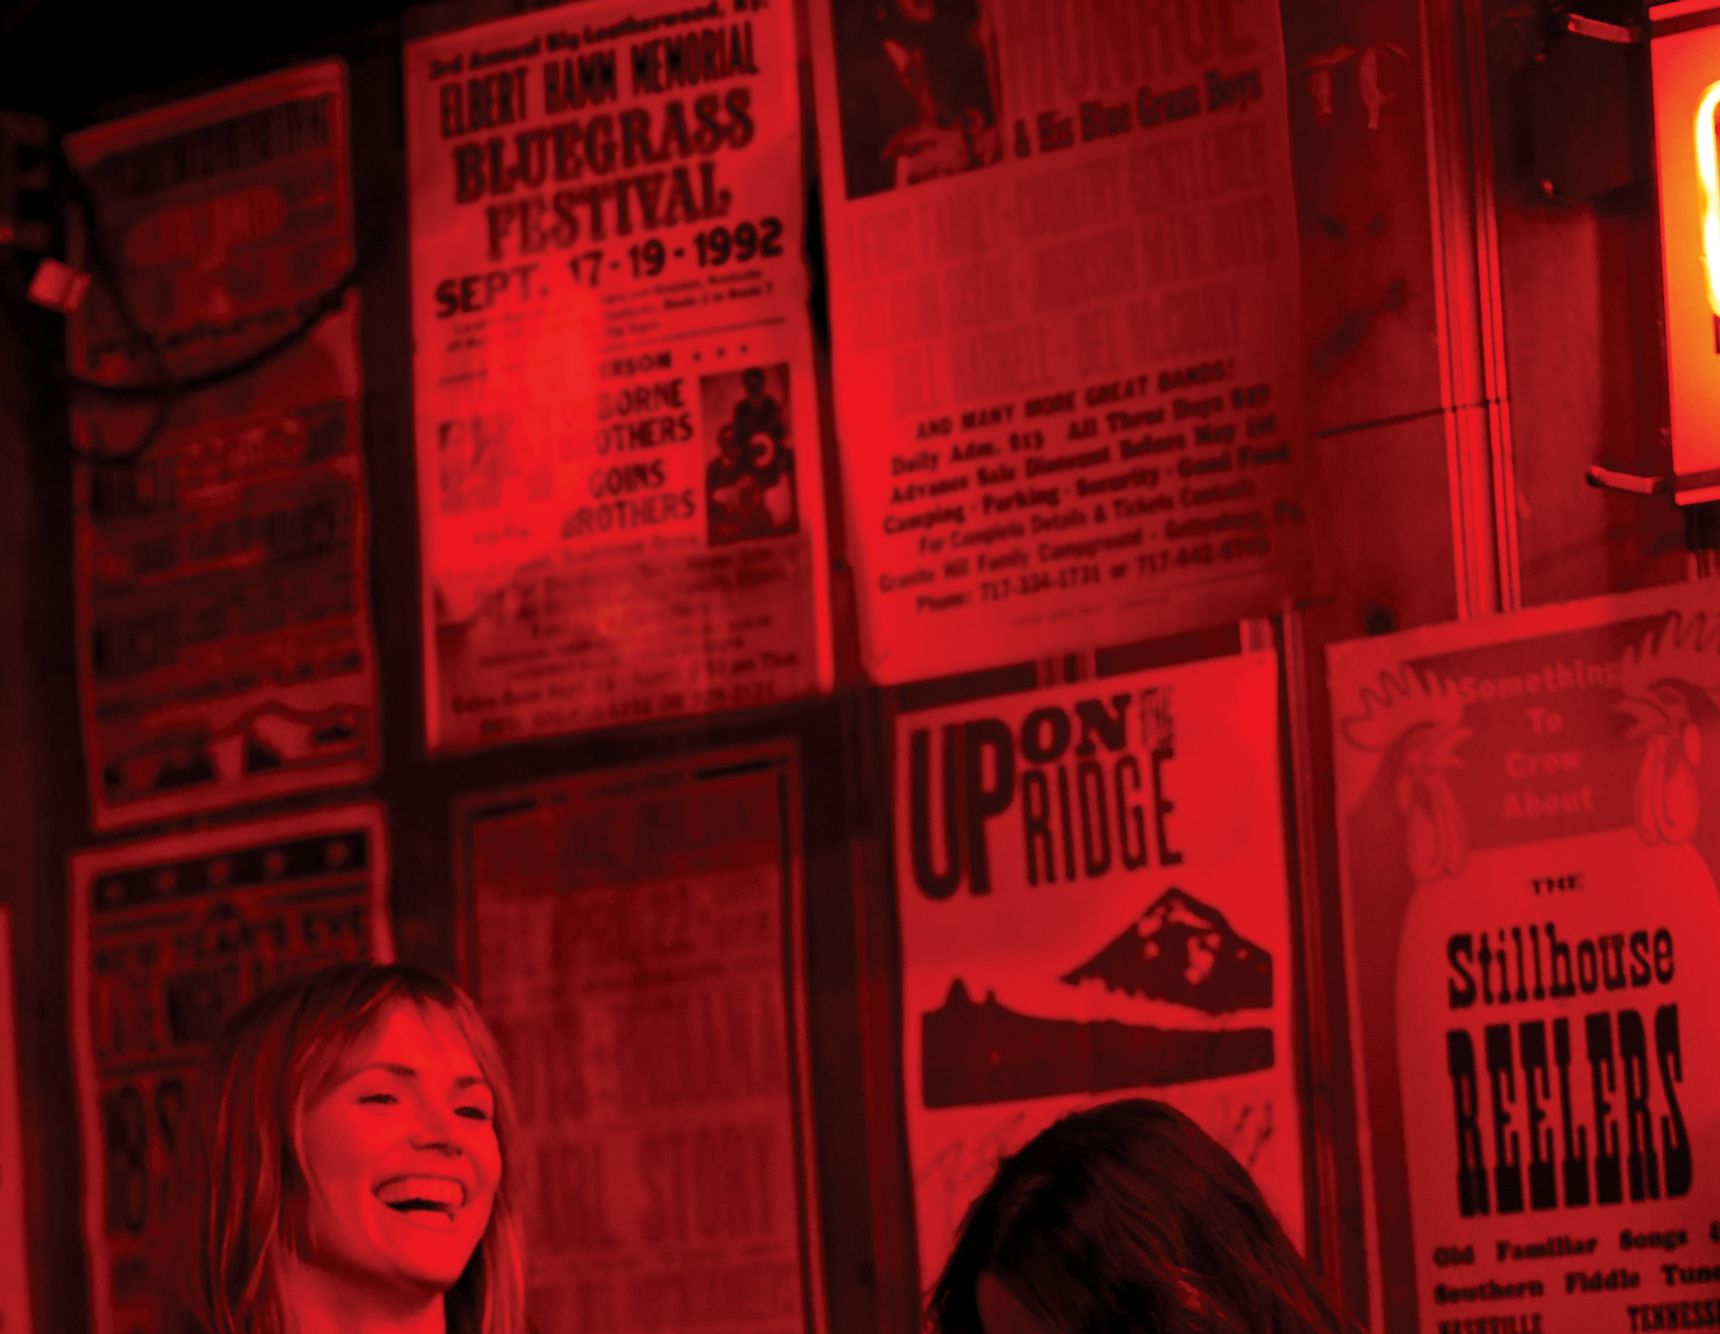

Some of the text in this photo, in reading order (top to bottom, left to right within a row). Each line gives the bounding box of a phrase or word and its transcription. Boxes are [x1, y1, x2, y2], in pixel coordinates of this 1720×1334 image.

[438, 66, 529, 139] ELBERT
[629, 20, 761, 97] MEMORIAL
[1036, 108, 1076, 154] His
[1077, 97, 1134, 144] Blue
[1134, 83, 1202, 130] Grass
[1202, 66, 1264, 114] Boys
[453, 86, 756, 205] BLUEGRASS
[486, 161, 732, 263] FESTIVAL
[434, 263, 549, 320] SEPT.
[890, 449, 940, 477] Daily
[1066, 414, 1099, 442] All
[1105, 408, 1165, 434] Three
[1172, 395, 1225, 421] Days
[915, 415, 954, 442] AND
[959, 403, 1016, 433] MANY
[1023, 390, 1077, 420] MORE
[1083, 375, 1149, 409] GREAT
[882, 504, 968, 536] Camping
[980, 485, 1062, 515] Parking
[1074, 467, 1159, 498] Security
[1177, 450, 1233, 479] Good
[889, 475, 970, 506] Advance
[975, 462, 1018, 488] Sale
[1023, 446, 1113, 479] Discount
[1119, 433, 1187, 460] Before
[949, 521, 1027, 550] Complete
[1526, 706, 1565, 736] To
[911, 718, 1014, 898] UP
[1020, 692, 1133, 764] ON
[1502, 784, 1595, 819] About
[1504, 748, 1584, 780] Crow
[1023, 749, 1185, 889] RIDGE
[1529, 873, 1584, 897] THE
[1445, 919, 1676, 1011] Stillhouse
[1445, 1001, 1695, 1217] REELERS
[1434, 1243, 1476, 1268] Old
[1496, 1234, 1599, 1263] Familiar
[1619, 1228, 1689, 1252] Songs
[1434, 1278, 1545, 1306] Southern
[1564, 1268, 1642, 1294] Fiddle
